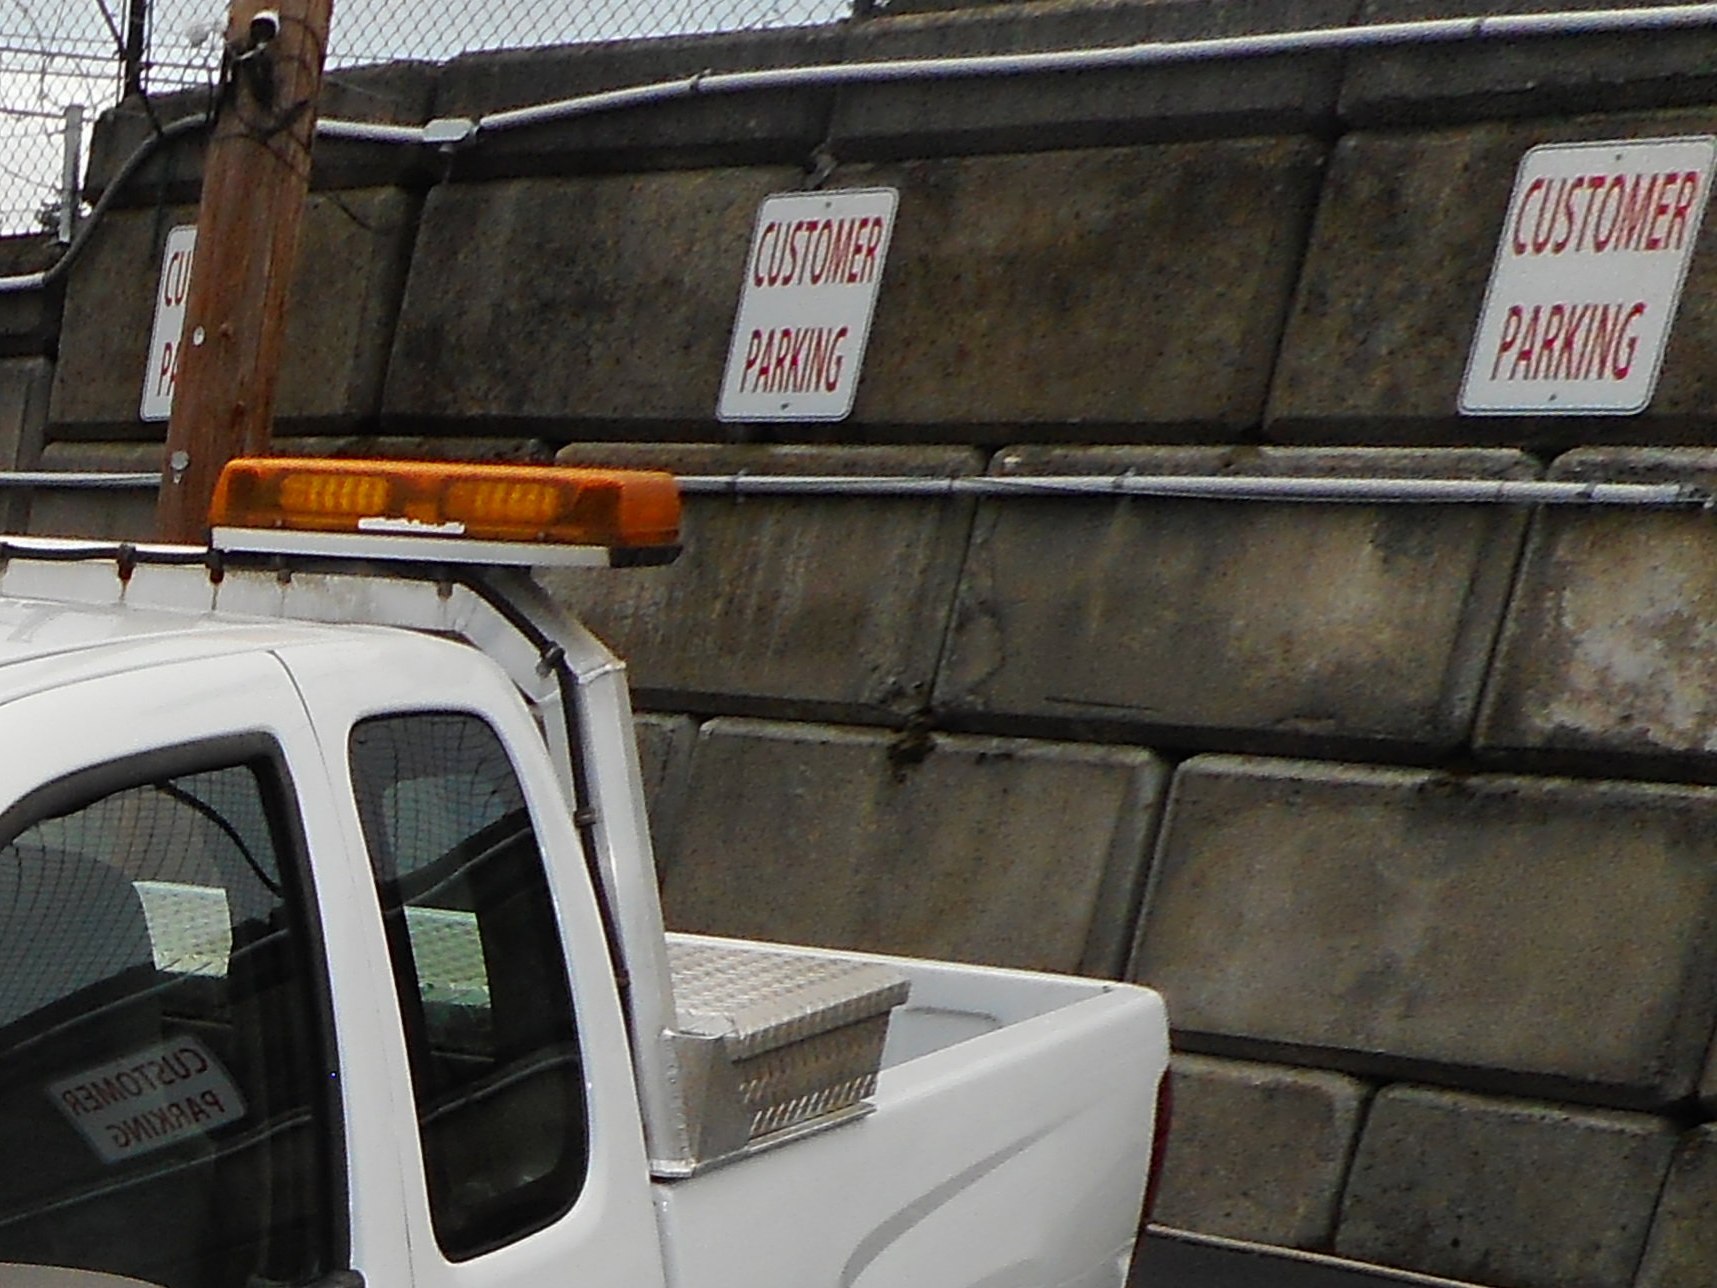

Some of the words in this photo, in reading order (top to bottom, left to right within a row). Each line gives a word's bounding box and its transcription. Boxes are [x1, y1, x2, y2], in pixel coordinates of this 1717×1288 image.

[1513, 171, 1700, 255] CUSTOMER
[754, 216, 883, 287] CUSTOMER
[740, 326, 848, 393] PARKING
[1490, 302, 1646, 381] PARKING
